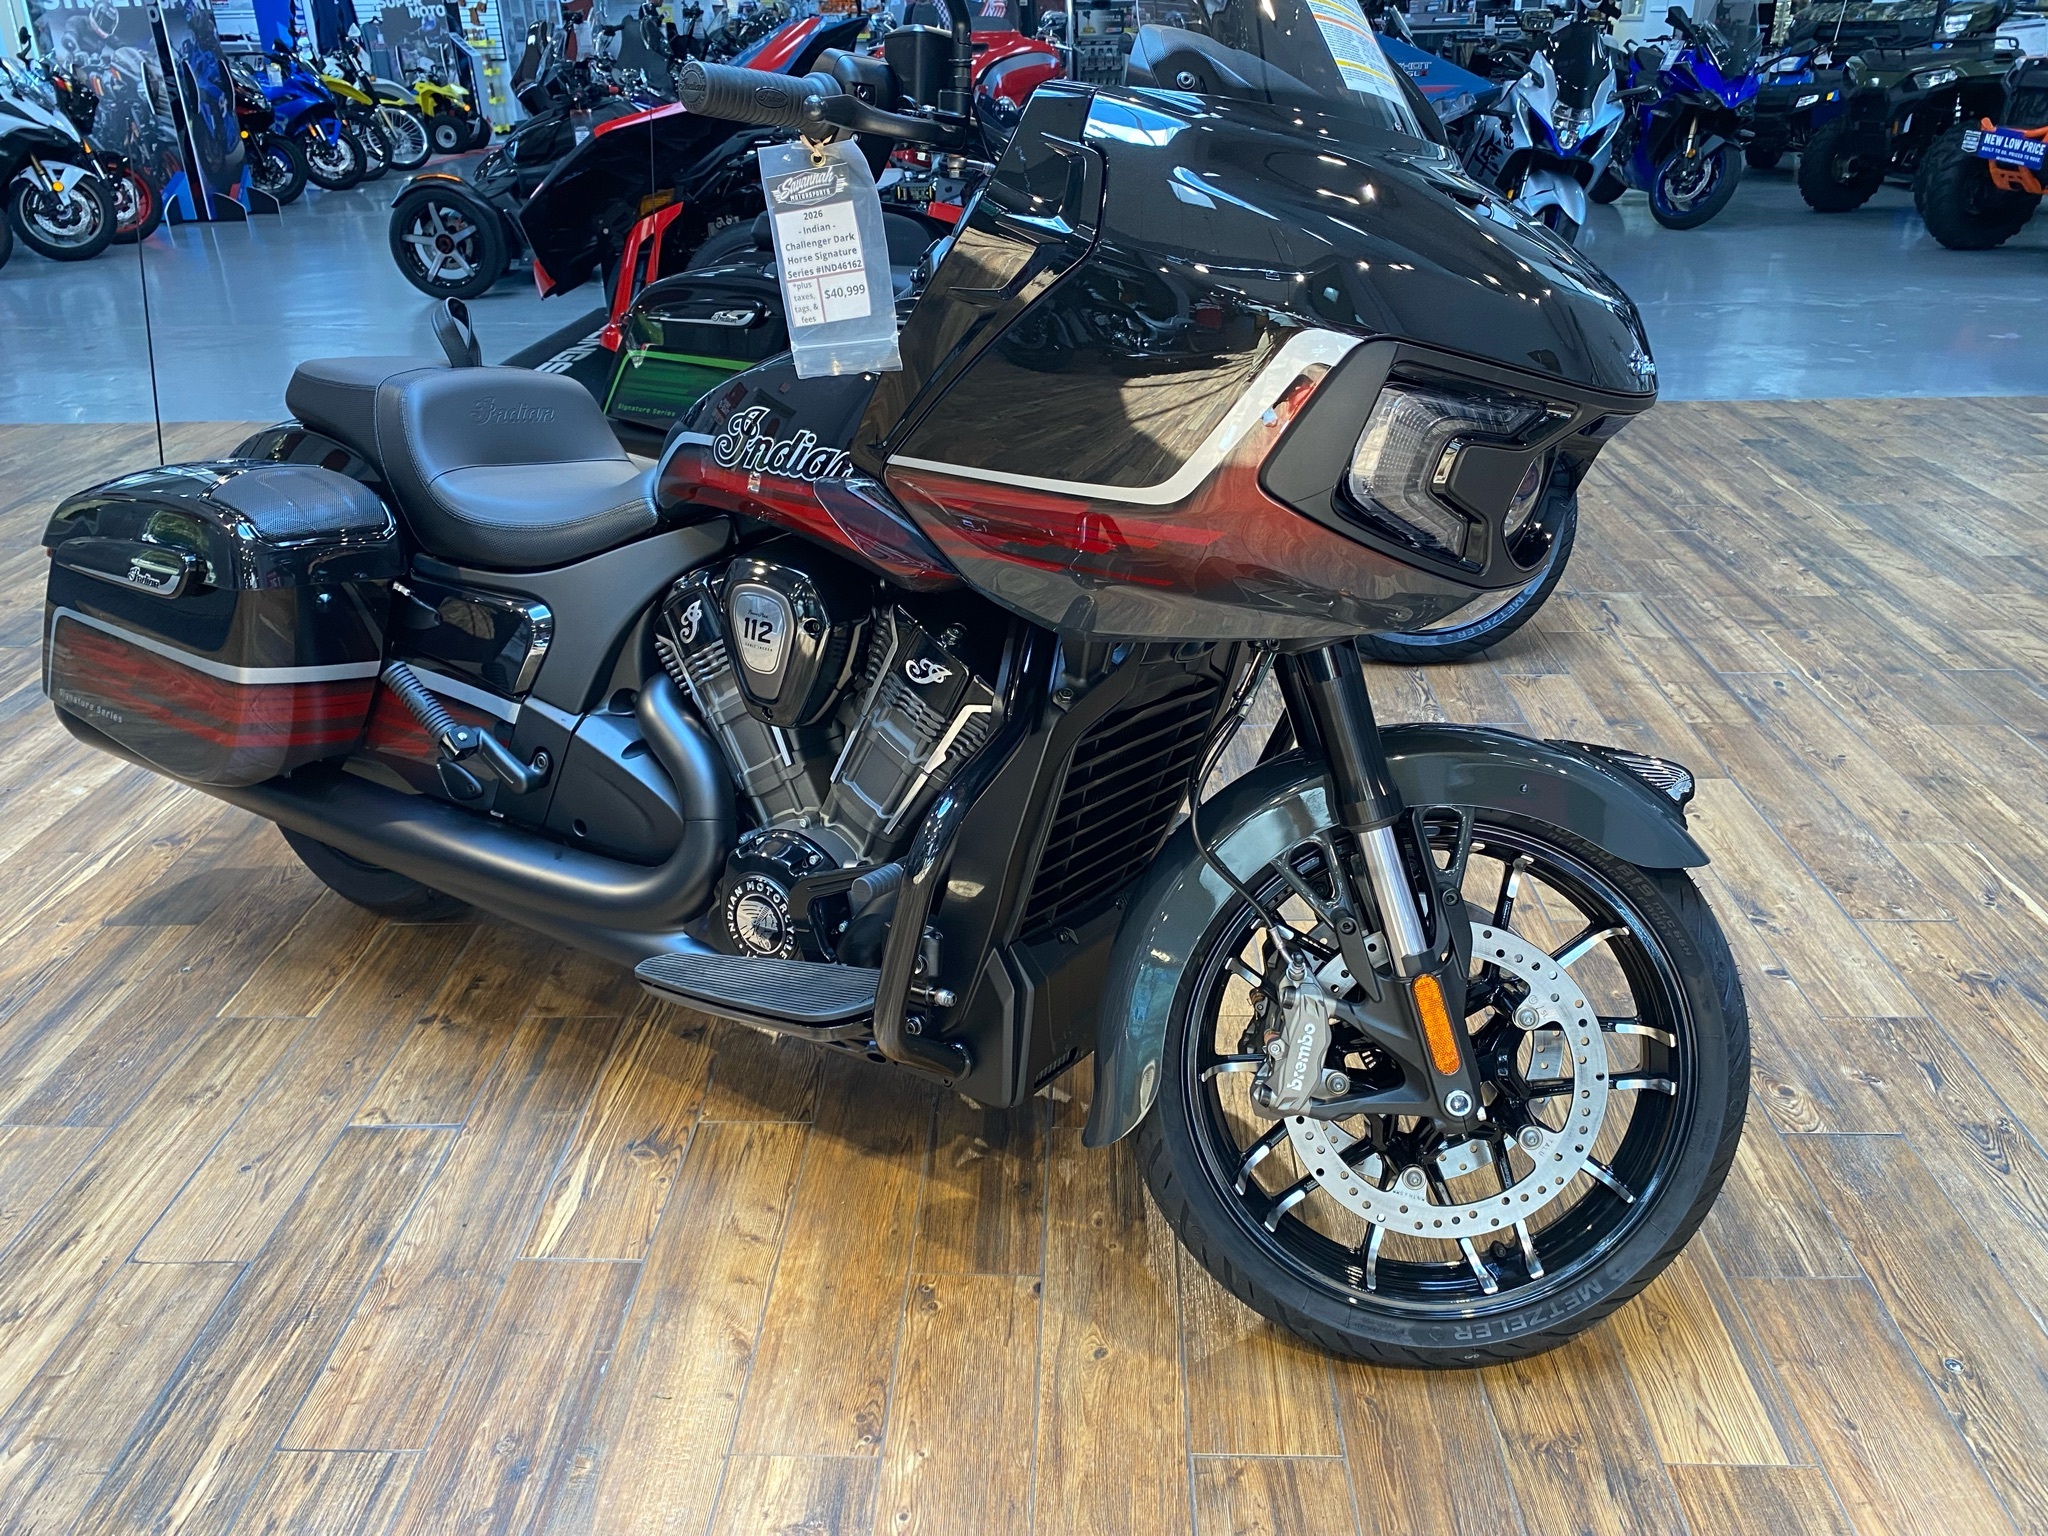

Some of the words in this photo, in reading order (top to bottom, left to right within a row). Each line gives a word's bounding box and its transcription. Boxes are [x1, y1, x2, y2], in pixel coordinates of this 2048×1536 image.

[408, 4, 446, 19] MOTO
[1984, 133, 2004, 147] NEW
[2003, 137, 2022, 150] LOW
[2022, 140, 2047, 155] PRICE
[780, 166, 834, 198] Savannah
[789, 187, 831, 202] MOTORSPORTS
[803, 209, 824, 221] 2026
[802, 223, 831, 236] Indian
[785, 236, 832, 252] Challenger
[833, 232, 856, 244] Dark
[787, 253, 813, 265] Horse
[814, 246, 858, 263] Signature
[787, 267, 814, 280] Series
[815, 259, 863, 275] #IND46162
[793, 292, 816, 302] taxes,
[823, 283, 866, 301] $40,999
[711, 311, 739, 324] Indian
[794, 304, 812, 315] tags,
[812, 303, 819, 312] &
[801, 315, 817, 325] fees
[468, 396, 556, 425] Indian
[617, 403, 651, 414] Signature
[652, 408, 676, 417] Series
[713, 406, 854, 482] Indian
[127, 566, 161, 589] Indian
[1457, 596, 1525, 640] METZELER
[744, 616, 773, 644] 112
[59, 688, 94, 711] Signature
[96, 706, 123, 724] Series
[1546, 832, 1634, 892] REINFORCED
[727, 885, 743, 940] INDIAN
[746, 881, 795, 960] MOTORCYCLE
[1286, 1022, 1316, 1092] brembo
[1454, 1279, 1604, 1341] METZELER
